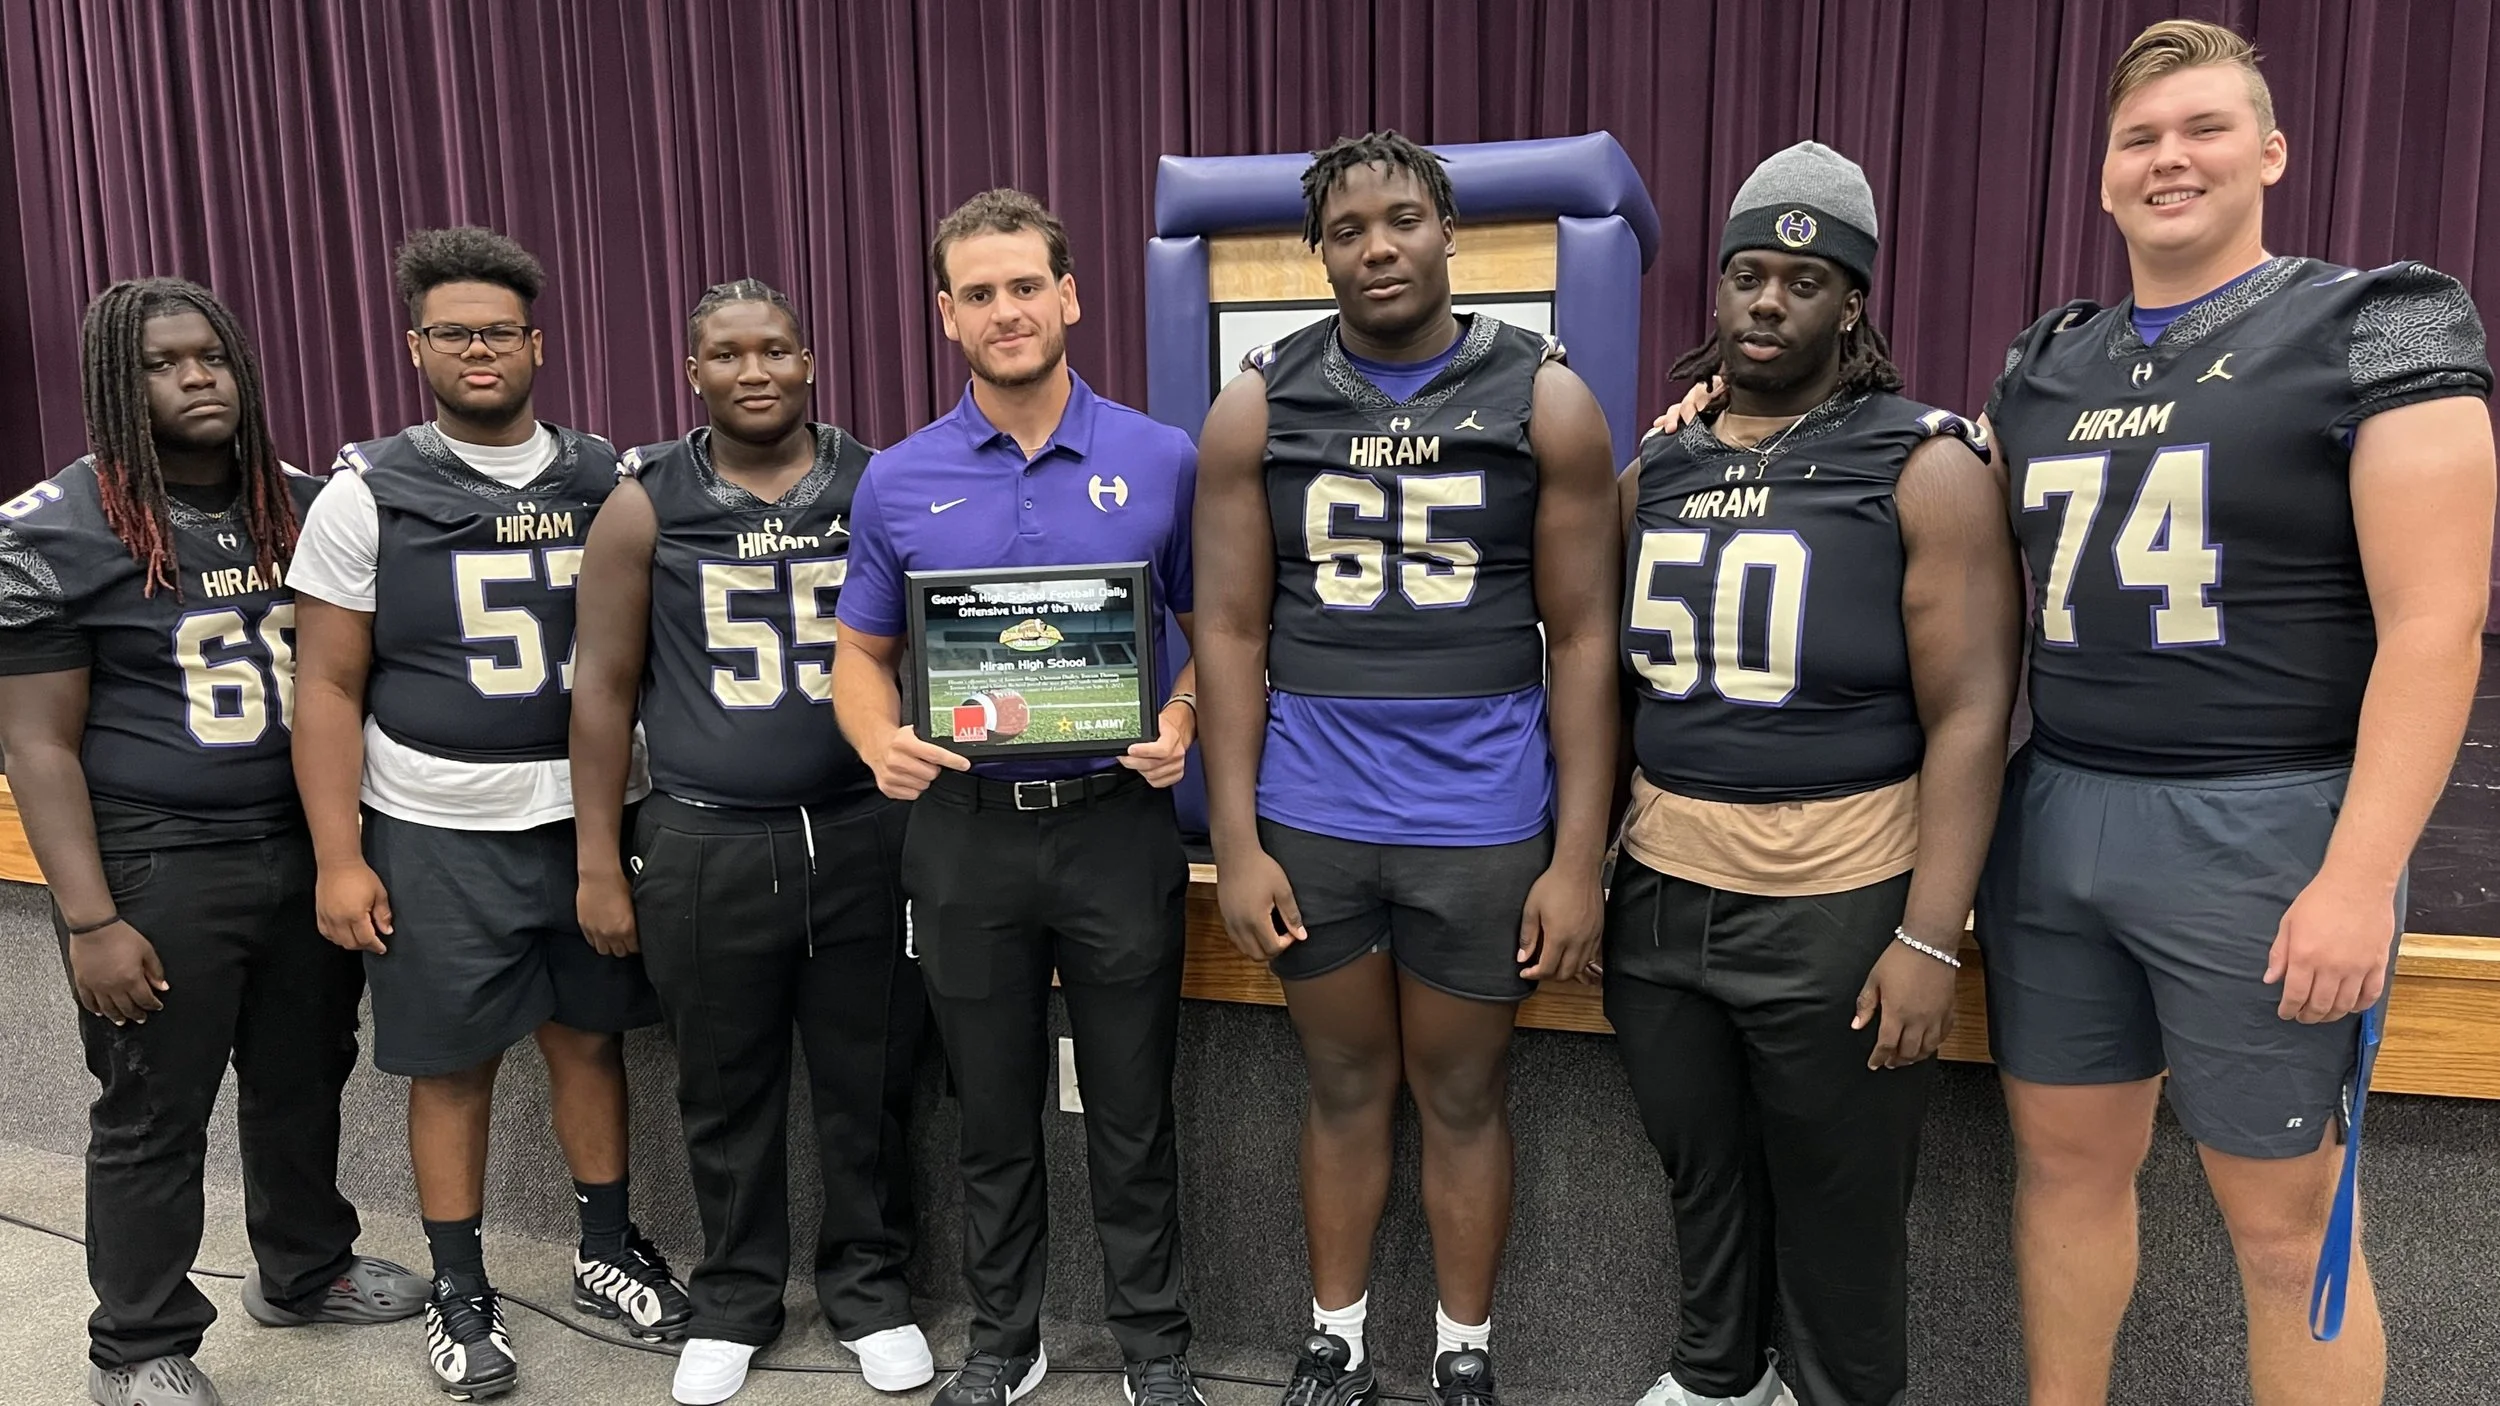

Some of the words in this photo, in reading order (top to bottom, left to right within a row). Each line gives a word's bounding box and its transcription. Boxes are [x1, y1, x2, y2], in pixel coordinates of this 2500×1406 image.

[2067, 401, 2176, 441] HIRAM
[1349, 436, 1440, 467] HIRAM
[1678, 487, 1770, 519] HIRAM
[496, 512, 575, 543] HIRAM
[1303, 470, 1488, 612] 65
[736, 531, 820, 559] HIRAM
[2022, 442, 2226, 650] 74
[931, 593, 976, 608] Georgia
[979, 592, 1005, 606] High
[1008, 591, 1046, 602] School
[1050, 590, 1095, 601] Football
[1099, 587, 1127, 599] Daily
[958, 605, 1010, 618] Offensive
[1012, 604, 1034, 616] Line
[1036, 603, 1049, 614] of
[1051, 603, 1069, 614] the
[1071, 602, 1102, 613] Week
[1628, 528, 1812, 708] 50
[980, 661, 1015, 672] Hiram
[1018, 659, 1044, 672] High
[1047, 657, 1087, 668] School
[1075, 720, 1095, 730] U.S.
[1095, 718, 1126, 729] ARMY
